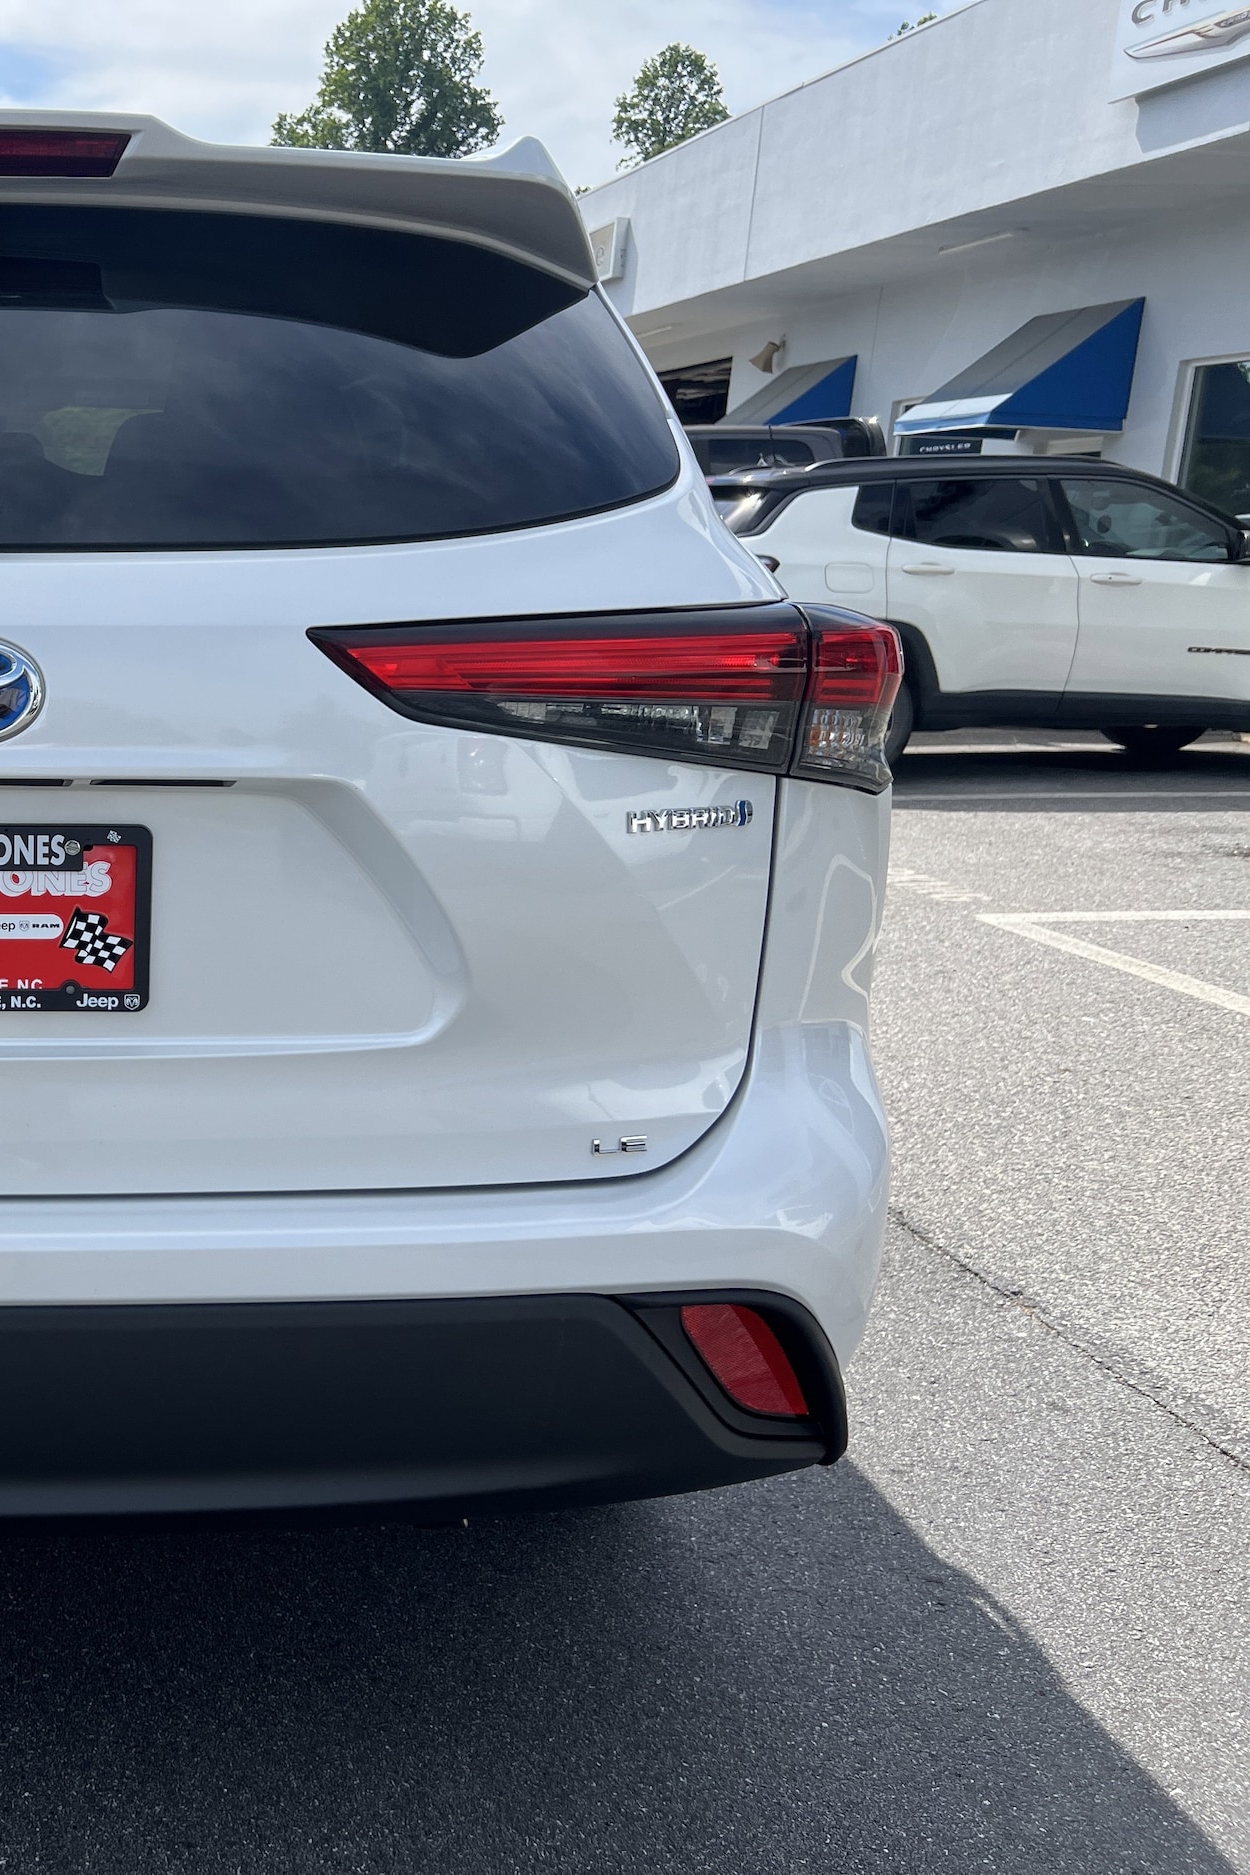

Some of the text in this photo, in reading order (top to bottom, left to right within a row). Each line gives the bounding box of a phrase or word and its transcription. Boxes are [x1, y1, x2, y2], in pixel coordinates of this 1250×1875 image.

[626, 805, 736, 834] HYBRID
[18, 978, 43, 989] NC
[11, 995, 41, 1009] N.C.
[76, 993, 119, 1010] Jeep
[591, 1134, 648, 1156] LE
